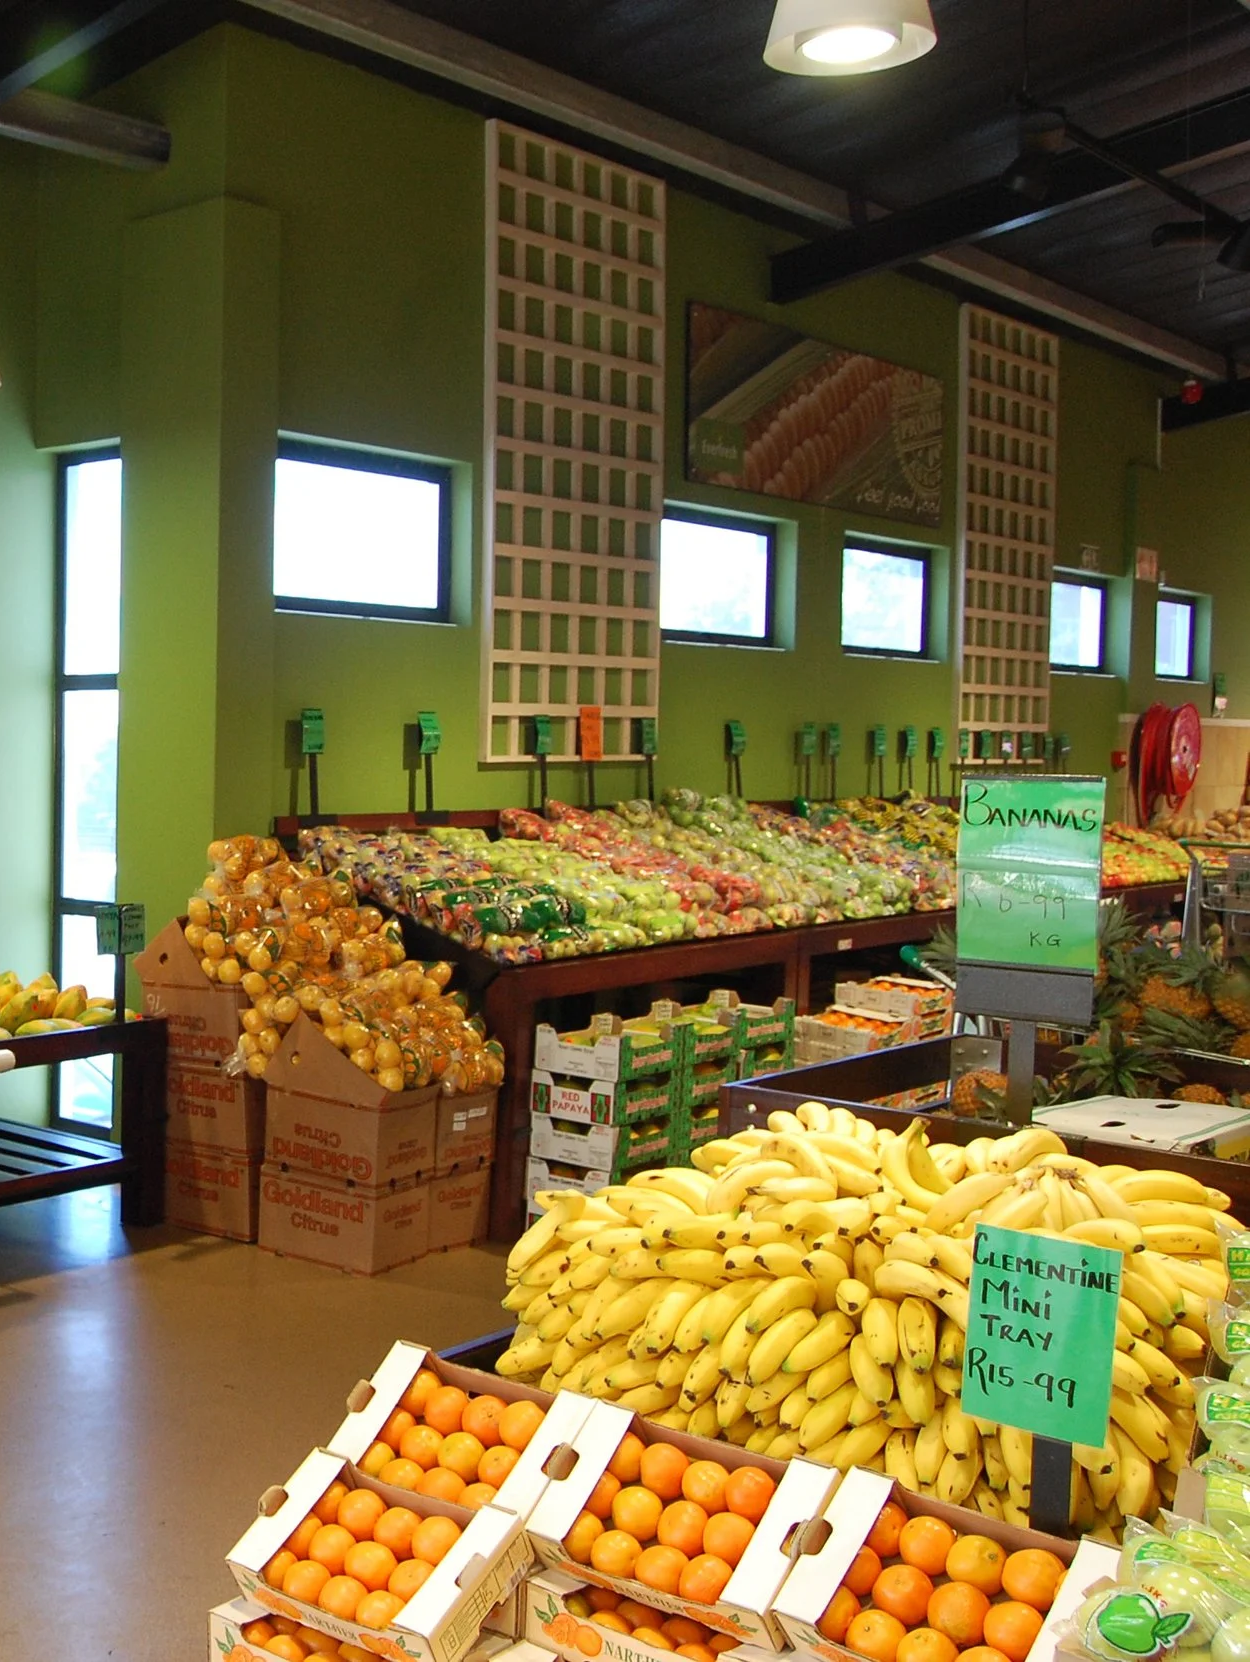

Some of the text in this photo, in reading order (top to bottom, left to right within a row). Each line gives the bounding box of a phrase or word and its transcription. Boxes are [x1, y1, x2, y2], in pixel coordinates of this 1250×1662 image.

[964, 783, 1097, 832] BANANAS
[168, 1074, 235, 1103] oldland
[562, 1091, 580, 1102] RED
[176, 1100, 217, 1118] Citrus
[552, 1100, 590, 1115] PAPAYA
[273, 1137, 373, 1180] Goldland
[263, 1179, 363, 1223] Goldland
[291, 1212, 339, 1236] Citrus
